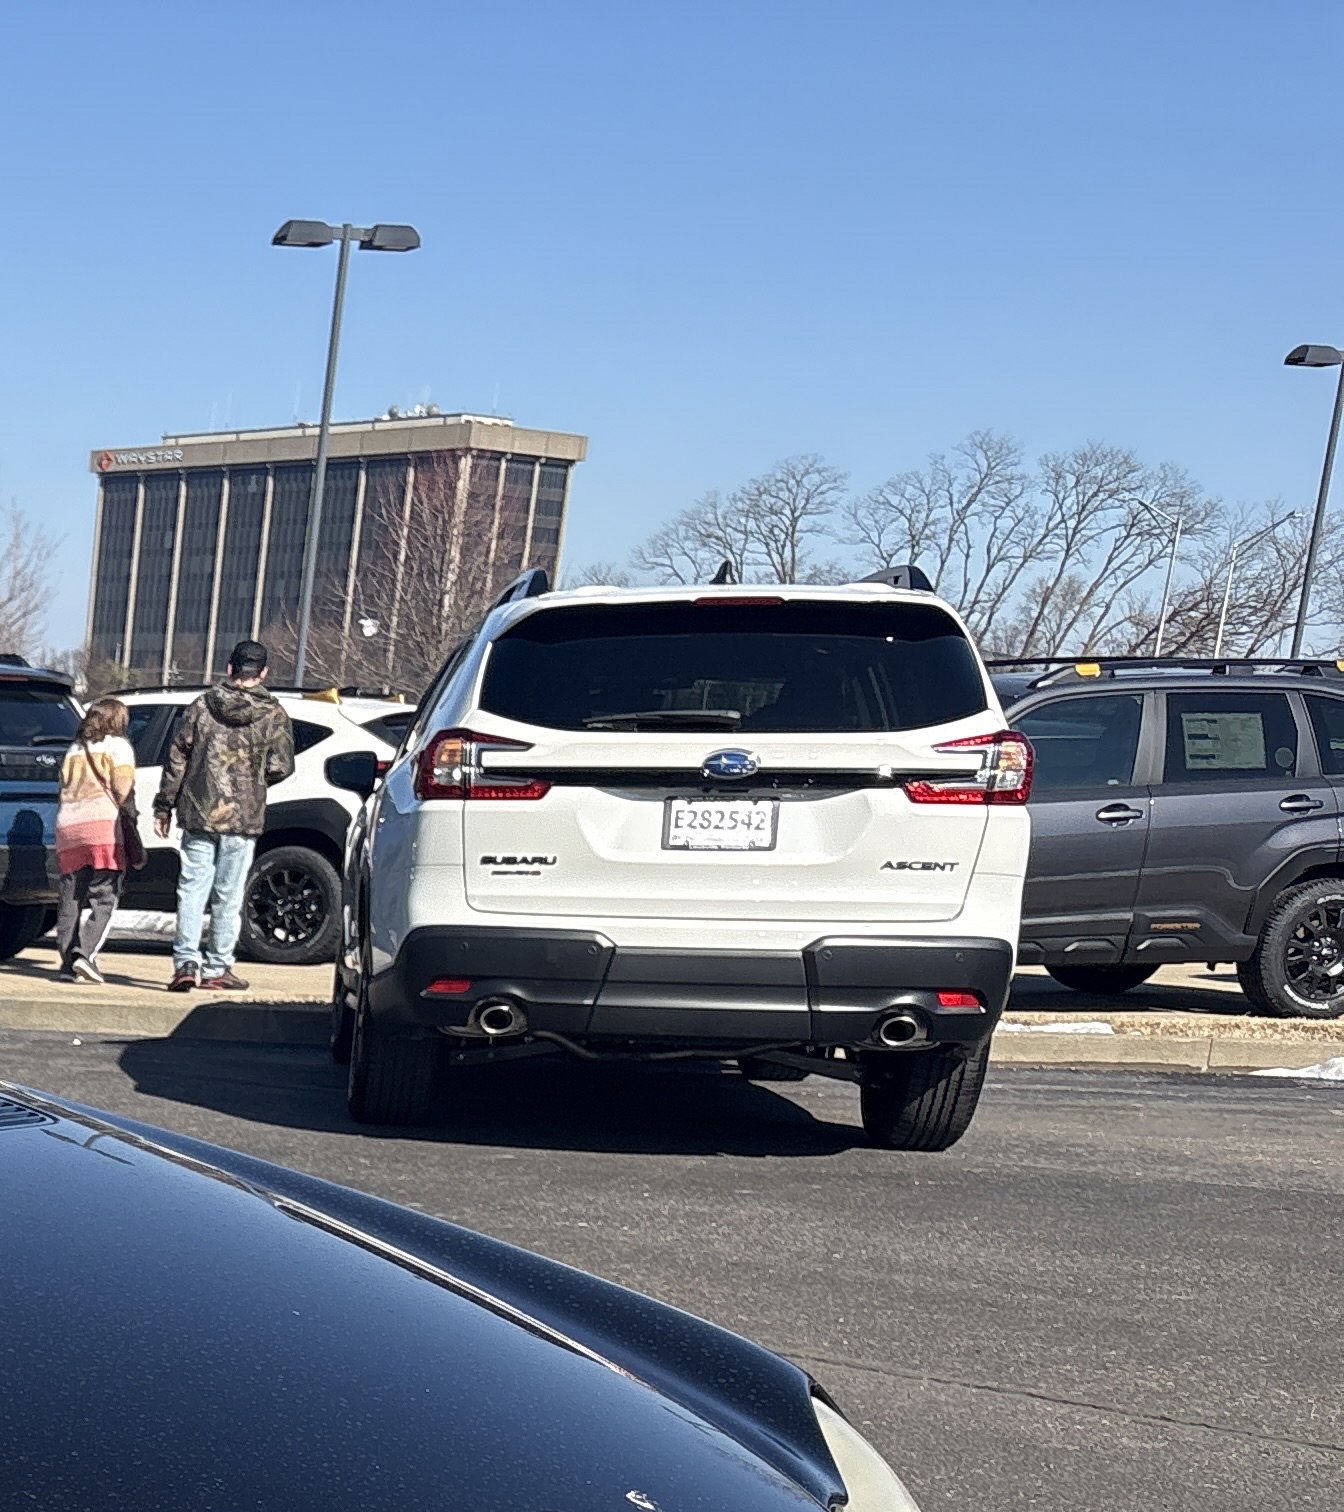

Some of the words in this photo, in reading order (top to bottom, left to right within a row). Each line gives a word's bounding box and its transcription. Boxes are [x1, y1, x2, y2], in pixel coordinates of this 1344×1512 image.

[115, 449, 184, 465] WAYSTAR
[480, 856, 557, 866] SUBARU
[880, 861, 959, 872] ASCENT
